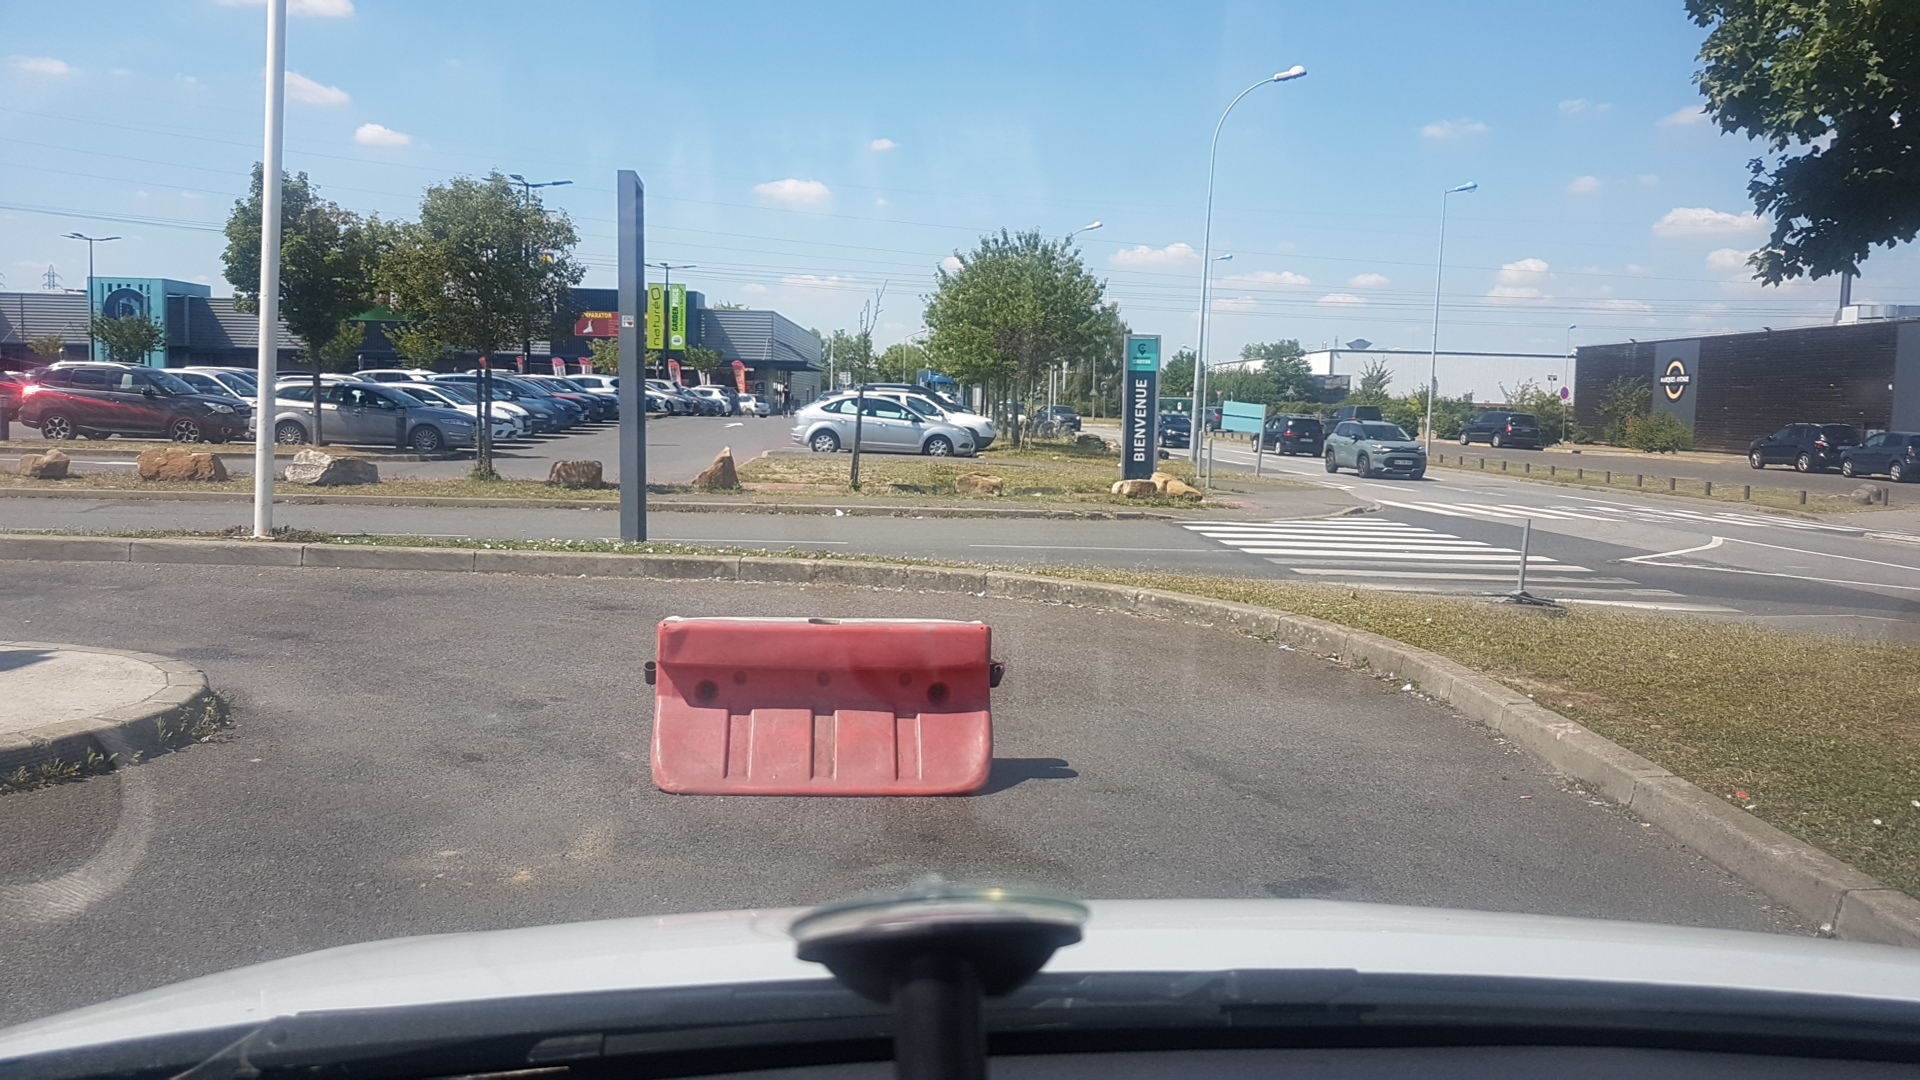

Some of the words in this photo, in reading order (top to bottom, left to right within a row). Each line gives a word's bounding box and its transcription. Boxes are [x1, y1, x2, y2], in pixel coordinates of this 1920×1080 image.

[671, 288, 679, 307] PRICE
[671, 306, 679, 332] GARDEN
[1133, 379, 1148, 462] BIENVENUE
